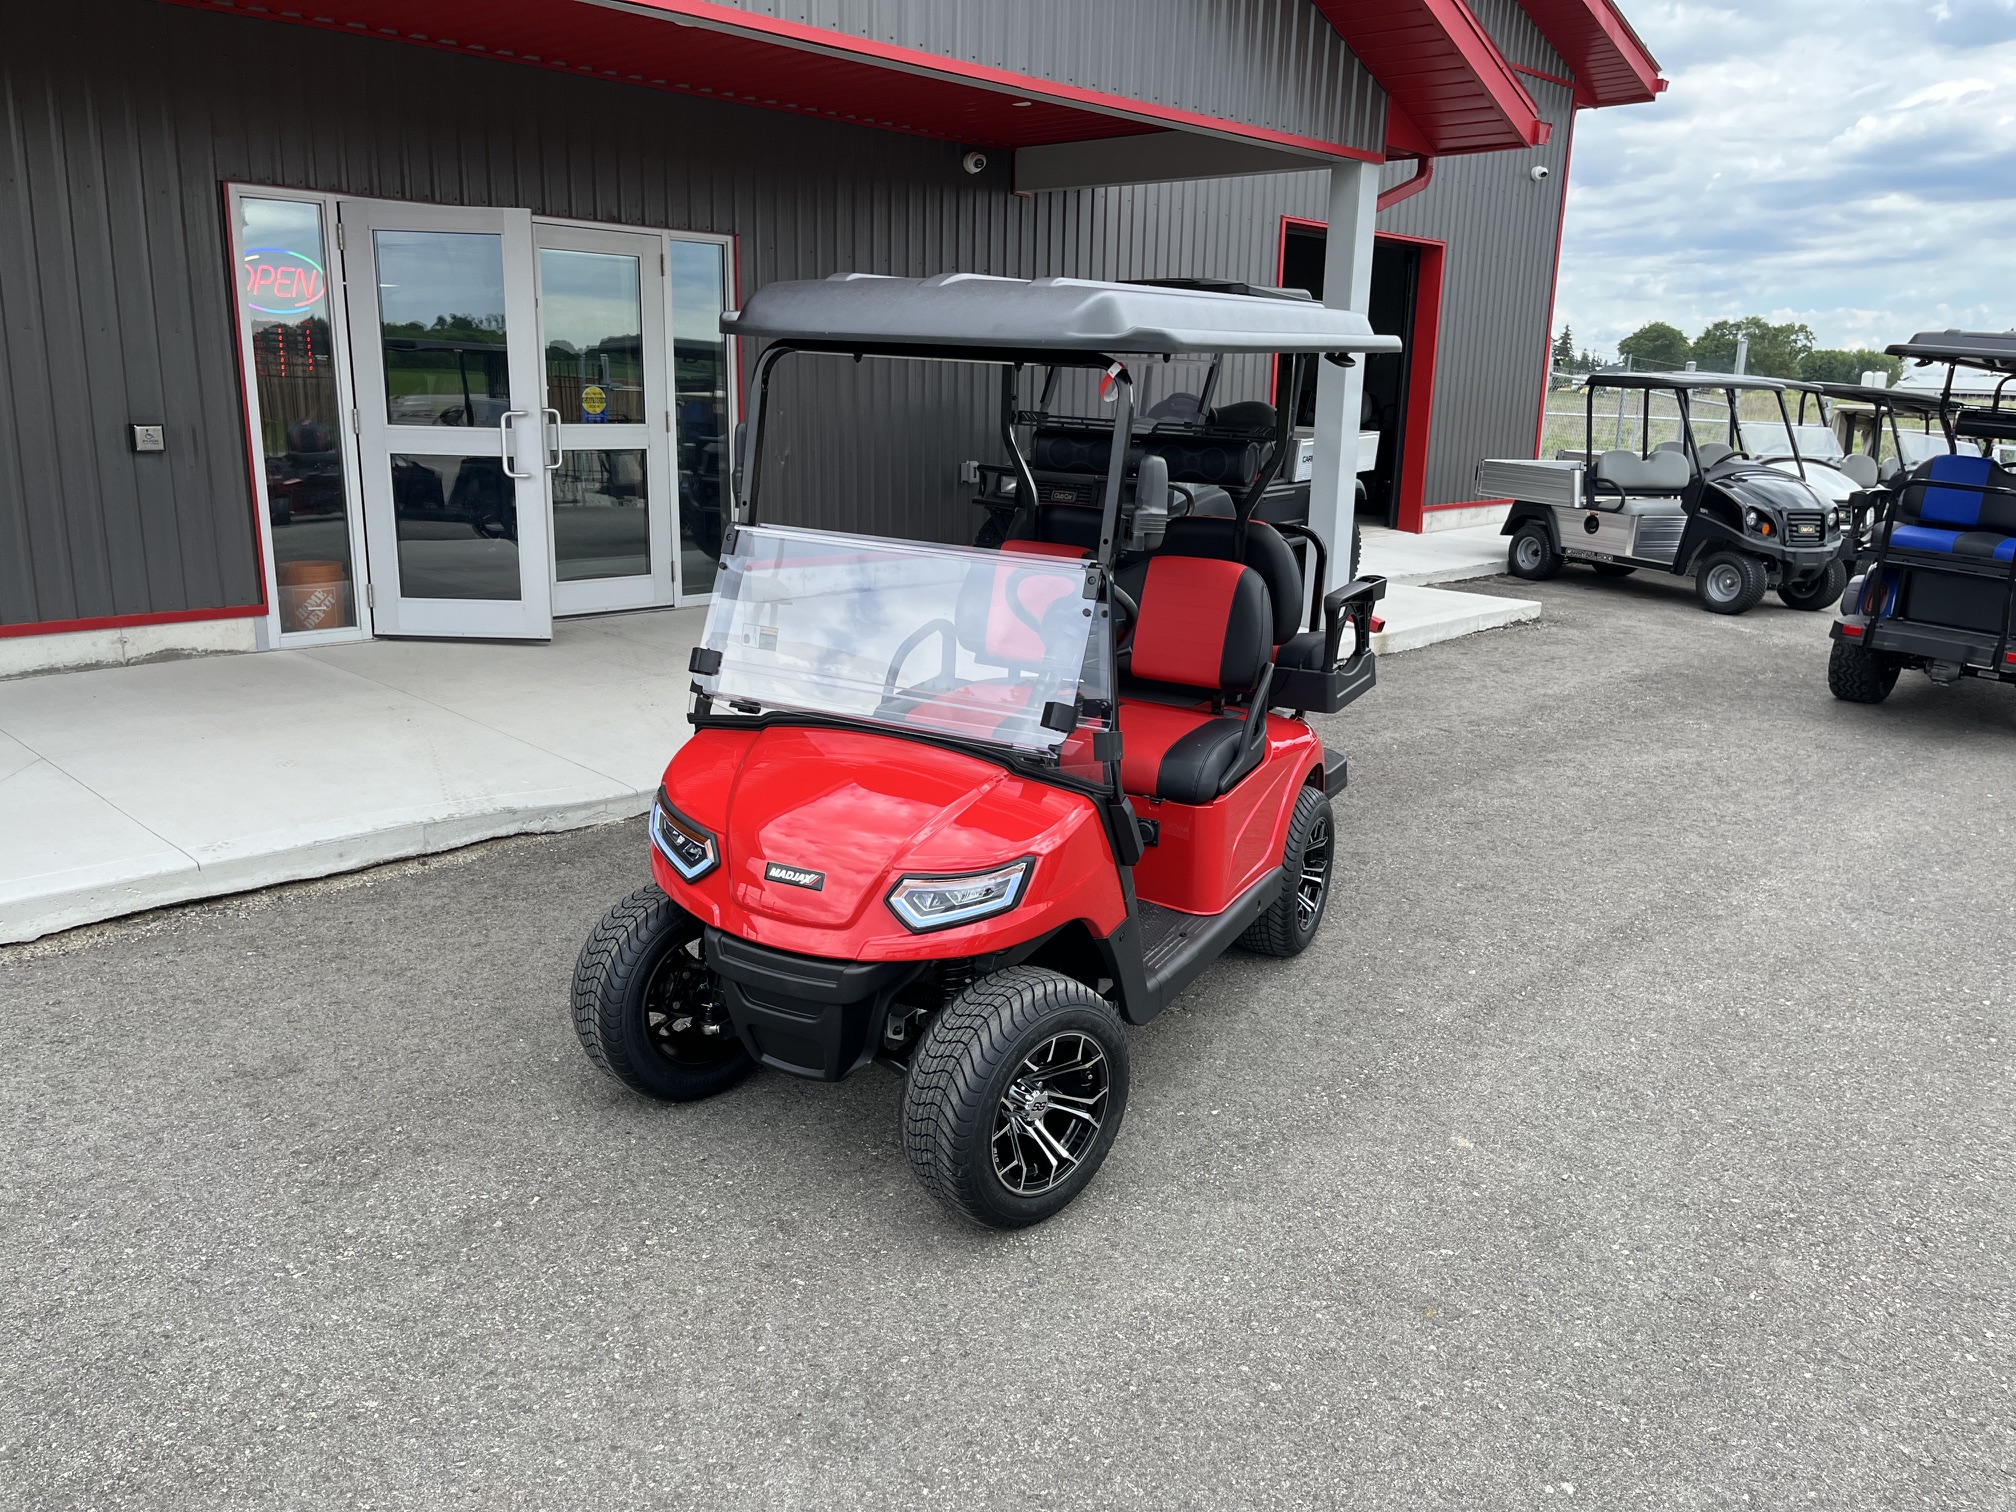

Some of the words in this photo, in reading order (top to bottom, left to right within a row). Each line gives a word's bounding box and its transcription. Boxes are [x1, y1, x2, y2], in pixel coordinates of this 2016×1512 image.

[297, 589, 327, 620] HOME
[303, 593, 336, 629] DEPOT
[769, 867, 818, 885] MADJAX
